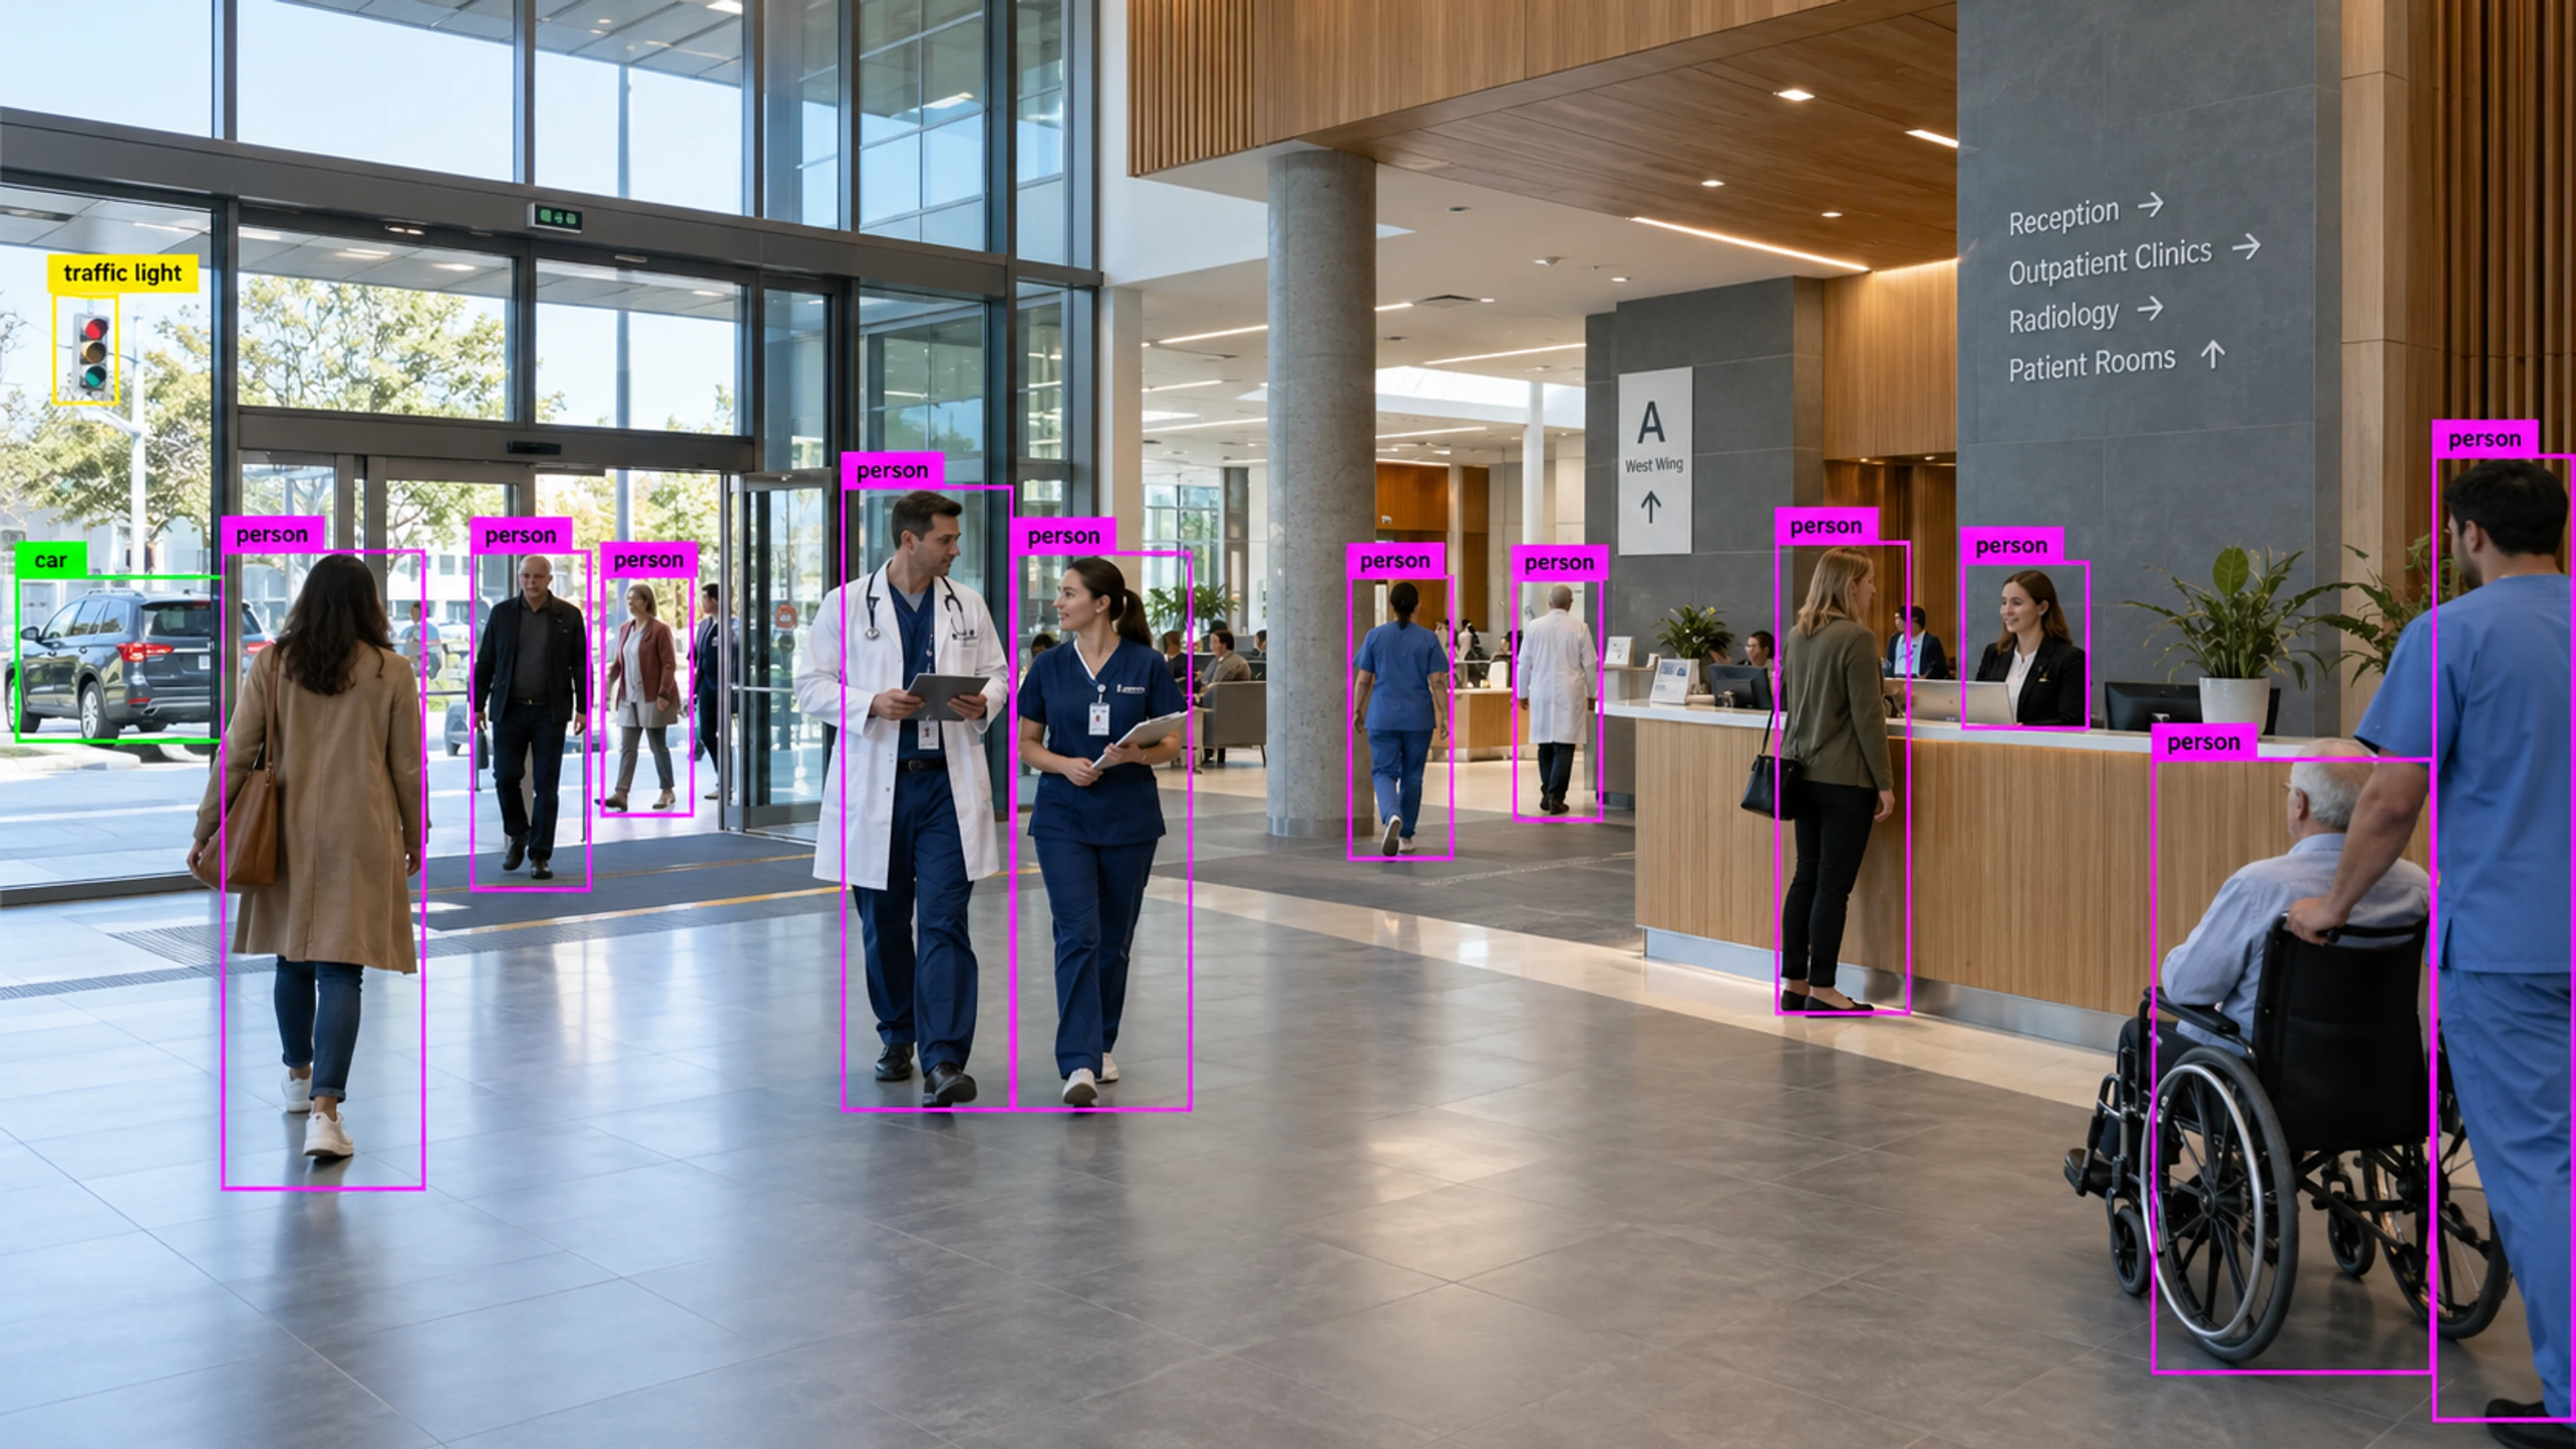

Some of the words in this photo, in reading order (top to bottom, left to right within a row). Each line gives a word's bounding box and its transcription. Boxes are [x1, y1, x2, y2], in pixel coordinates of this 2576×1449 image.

[2010, 200, 2119, 235] Reception
[2009, 249, 2128, 286] Outpatient
[2135, 239, 2212, 270] Clinics
[2010, 301, 2119, 333] Radiology
[2010, 353, 2088, 382] Patient
[2096, 349, 2176, 375] Rooms
[1637, 400, 1666, 444] A
[1625, 459, 1653, 473] West
[1655, 457, 1684, 474] Wing
